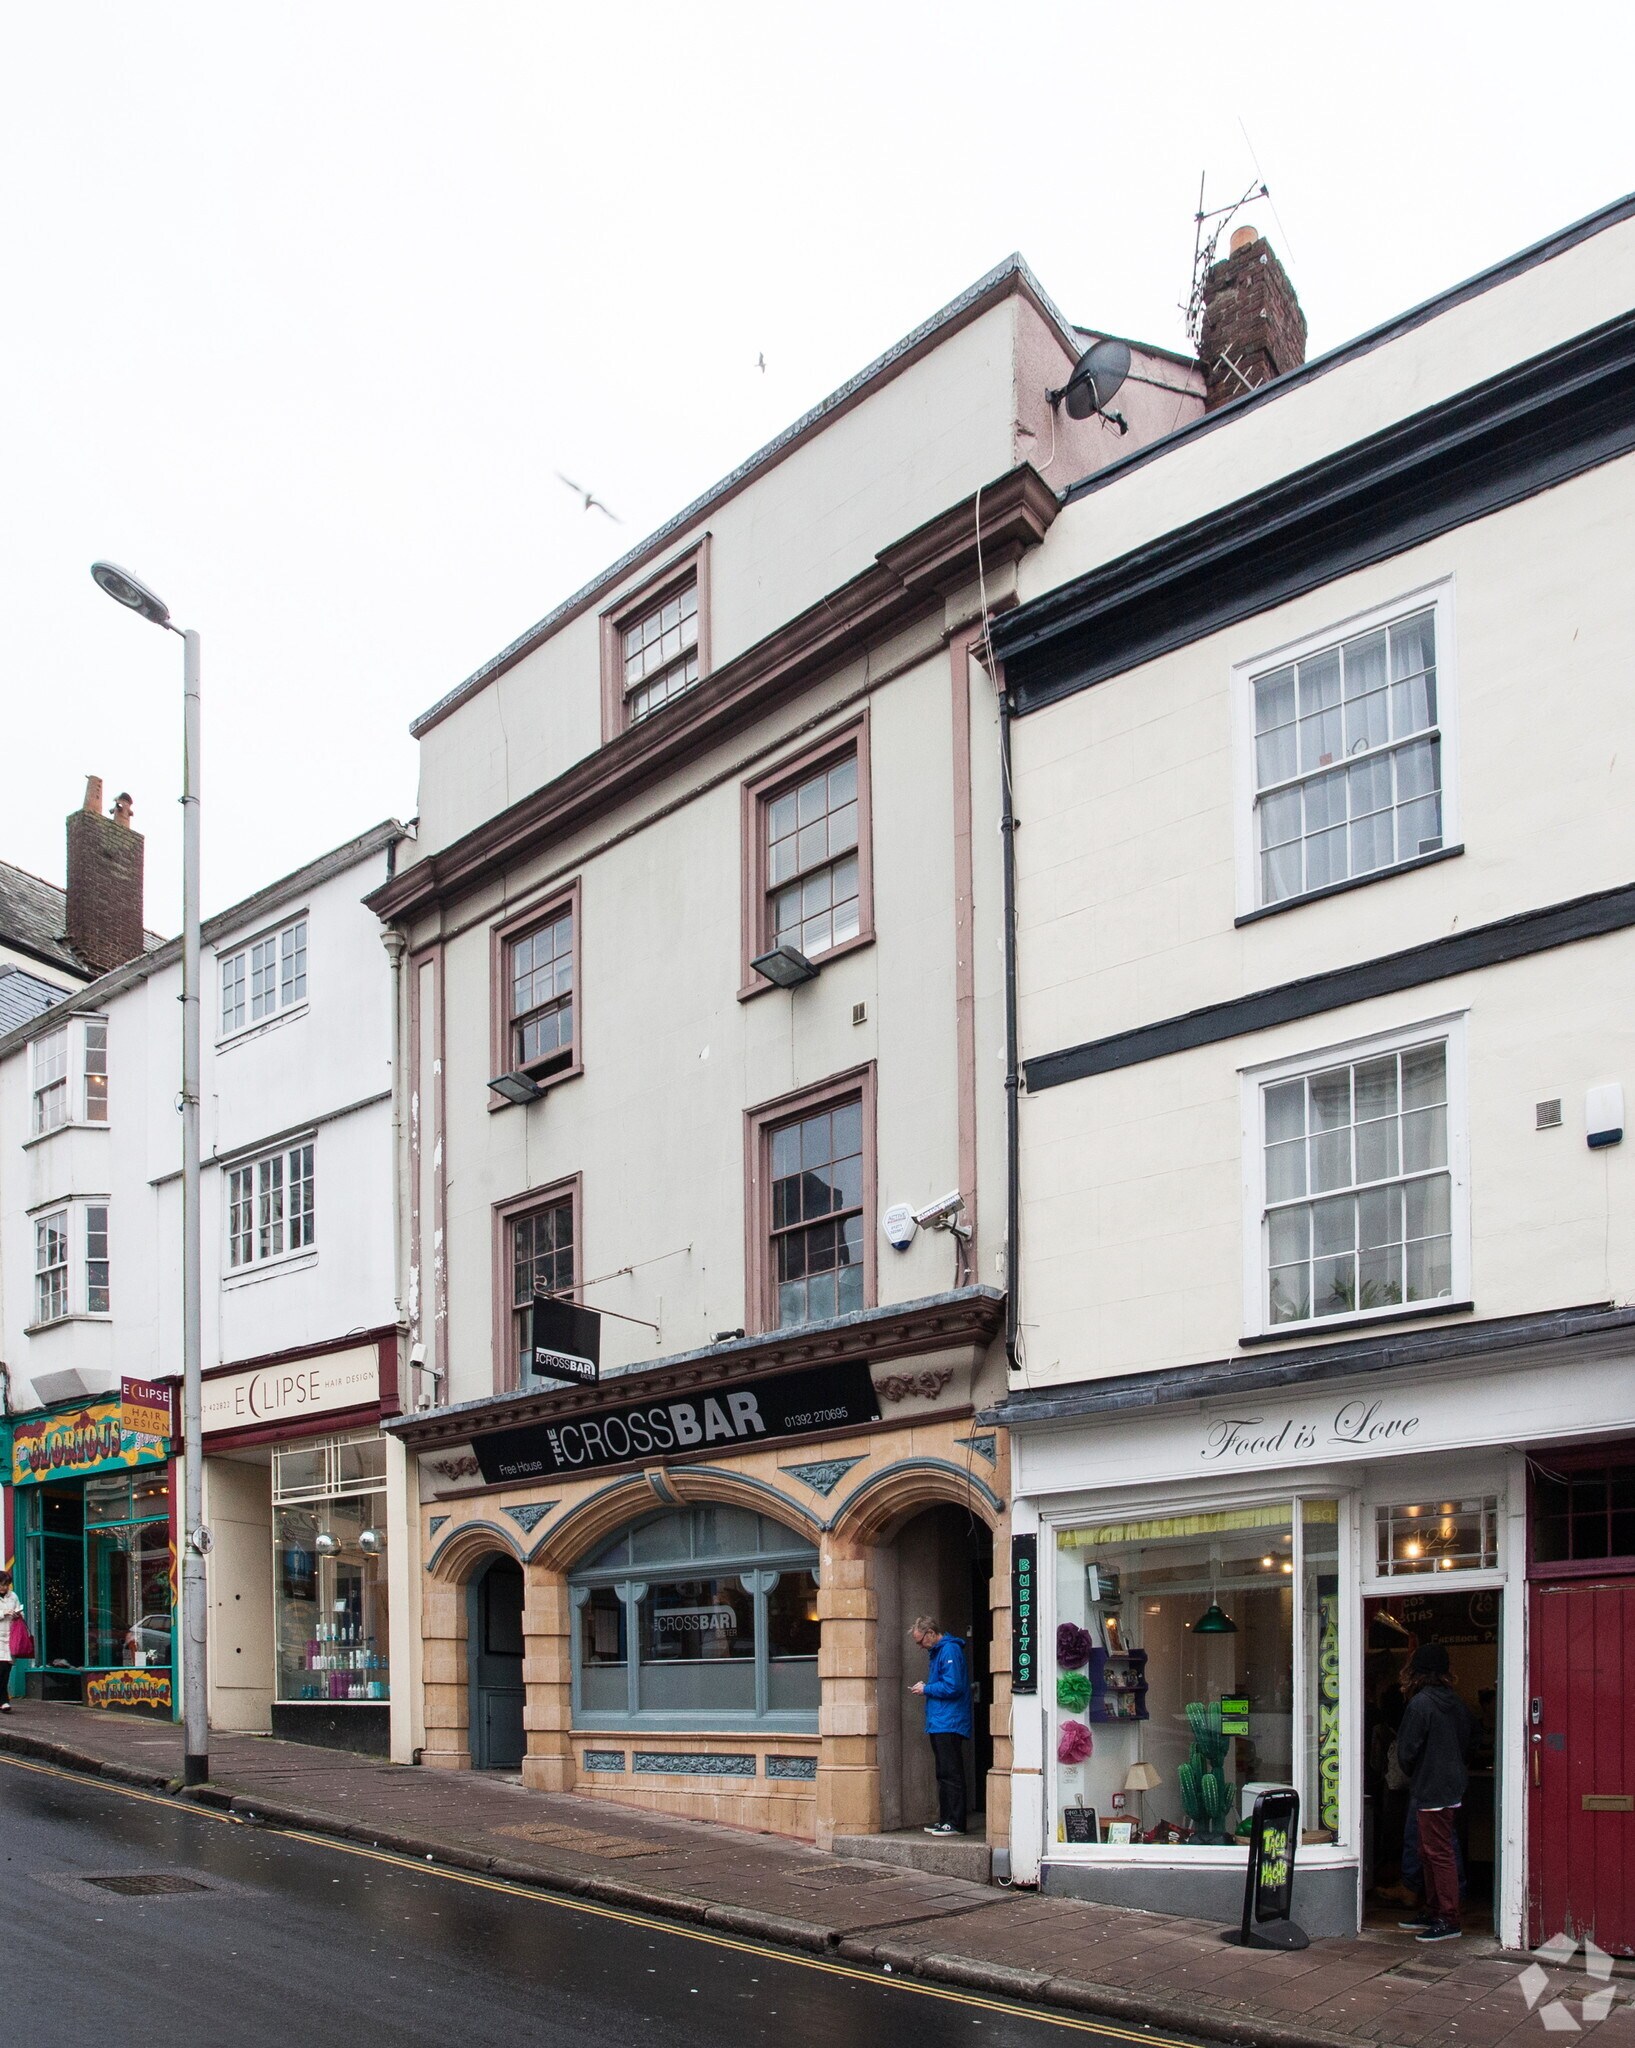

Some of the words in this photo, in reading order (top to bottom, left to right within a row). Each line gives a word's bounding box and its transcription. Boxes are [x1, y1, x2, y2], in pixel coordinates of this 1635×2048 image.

[540, 1353, 591, 1375] CROSSBAR
[123, 1383, 169, 1402] ECLIPSE
[235, 1370, 320, 1418] ECLIPSE
[324, 1379, 343, 1388] HAIR
[346, 1371, 375, 1385] DESIGN
[123, 1416, 169, 1432] DESIGN
[132, 1408, 162, 1421] HAIR
[499, 1463, 517, 1476] Free
[517, 1458, 543, 1473] House
[547, 1427, 565, 1466] THE
[560, 1391, 766, 1465] CROSSBAR
[784, 1412, 813, 1428] 01392
[813, 1406, 848, 1423] 270695
[1200, 1417, 1293, 1460] Food
[1294, 1424, 1316, 1450] is
[1326, 1399, 1420, 1444] Love
[29, 1420, 121, 1473] GLORIOUS
[1412, 1525, 1460, 1551] 122
[657, 1612, 730, 1632] CROSSBAR
